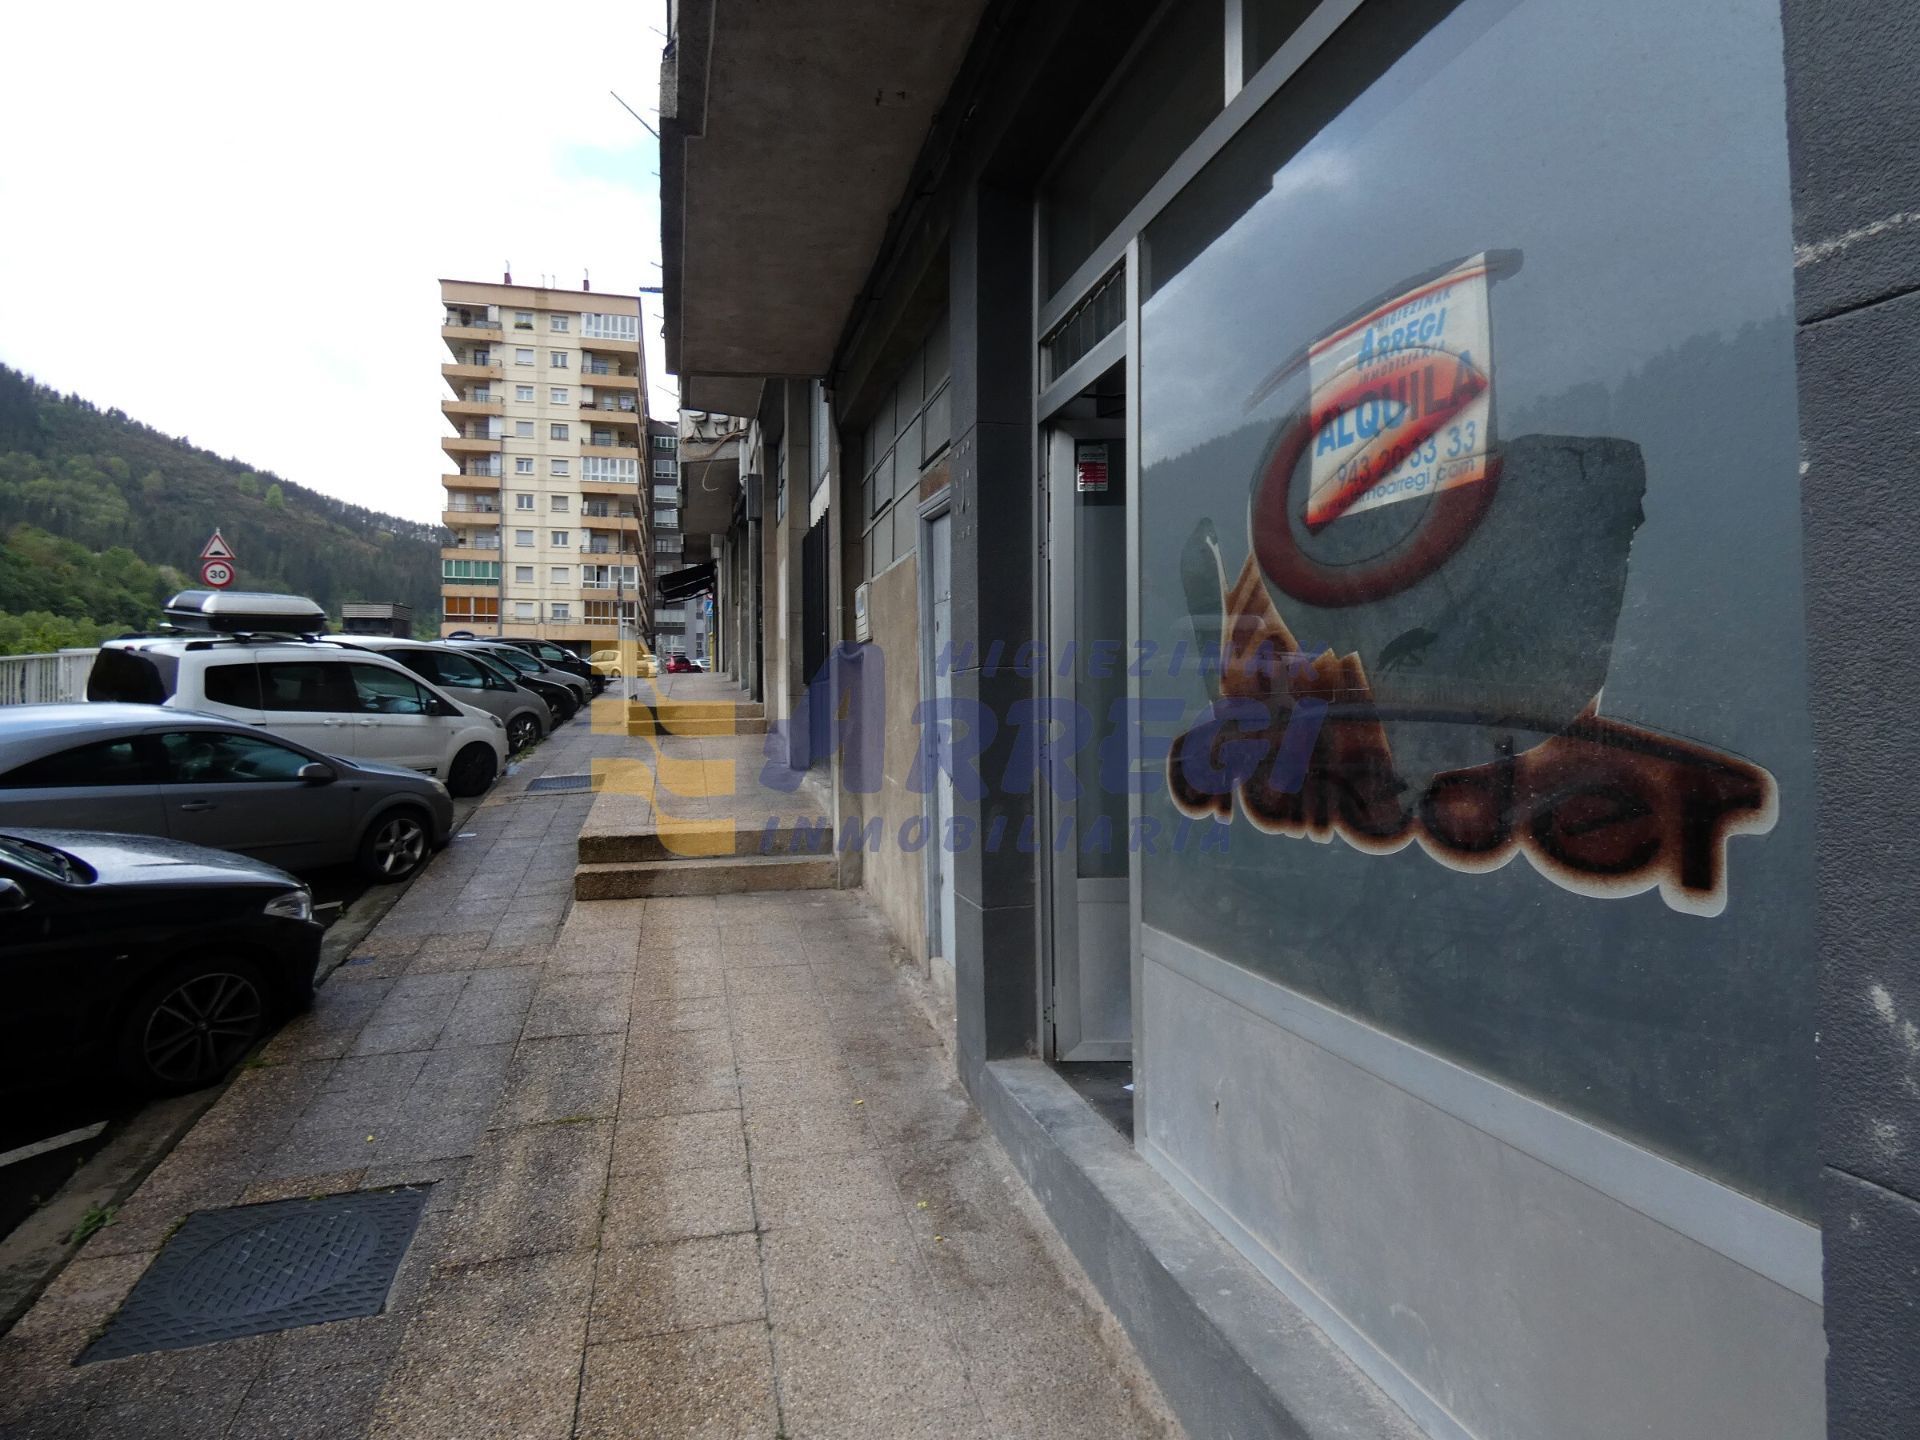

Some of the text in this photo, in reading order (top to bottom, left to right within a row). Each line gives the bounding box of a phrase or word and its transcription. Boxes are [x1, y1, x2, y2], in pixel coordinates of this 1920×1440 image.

[1357, 308, 1446, 370] ARREGI
[1316, 350, 1475, 457] ALQUILA
[1446, 420, 1476, 458] 33
[209, 569, 227, 579] 30
